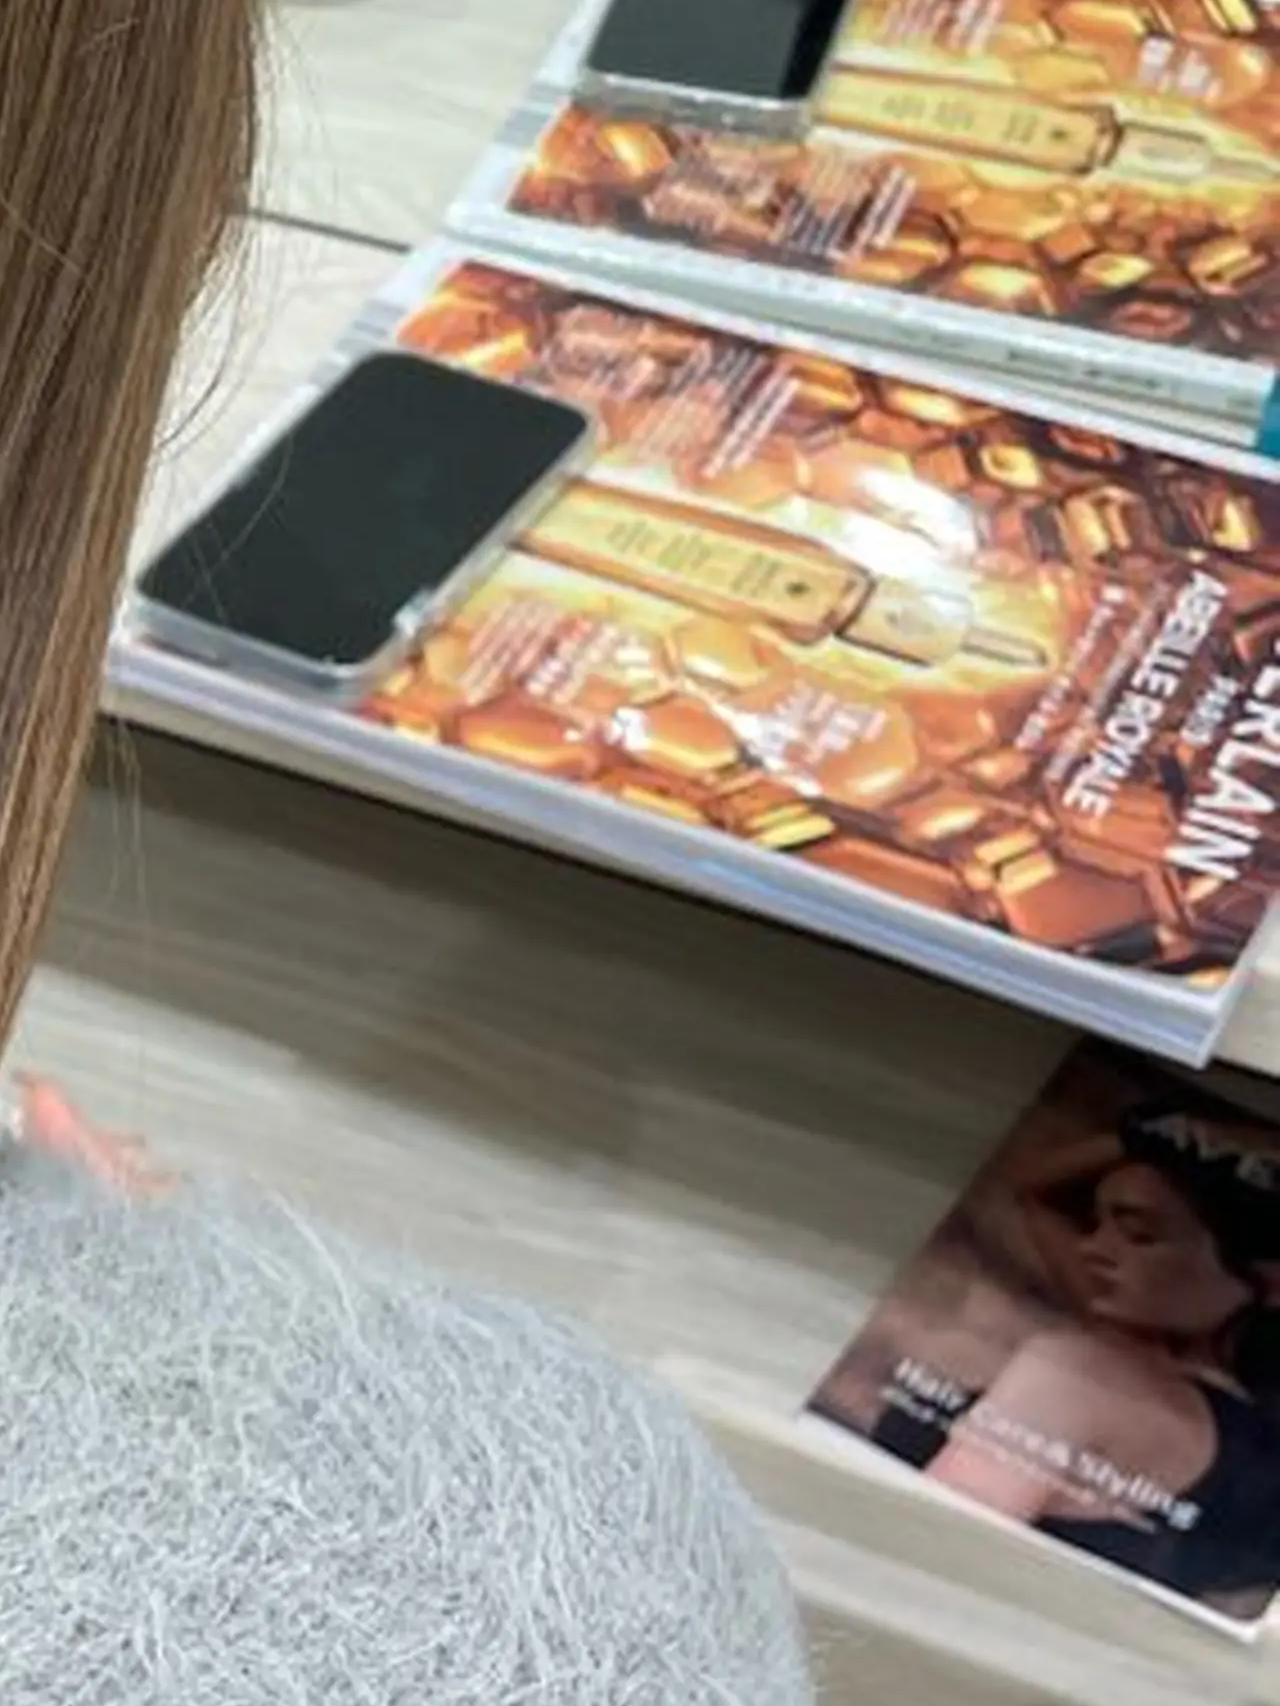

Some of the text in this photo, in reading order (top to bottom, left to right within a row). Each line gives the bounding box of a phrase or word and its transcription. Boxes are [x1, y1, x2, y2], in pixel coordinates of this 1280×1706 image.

[1130, 569, 1229, 698] ABEILLE
[1062, 691, 1166, 819] ROYALE
[1162, 636, 1280, 881] RLAIN
[894, 1356, 967, 1411] Hair
[969, 1399, 1045, 1452] Care
[1076, 1449, 1202, 1532] Styling
